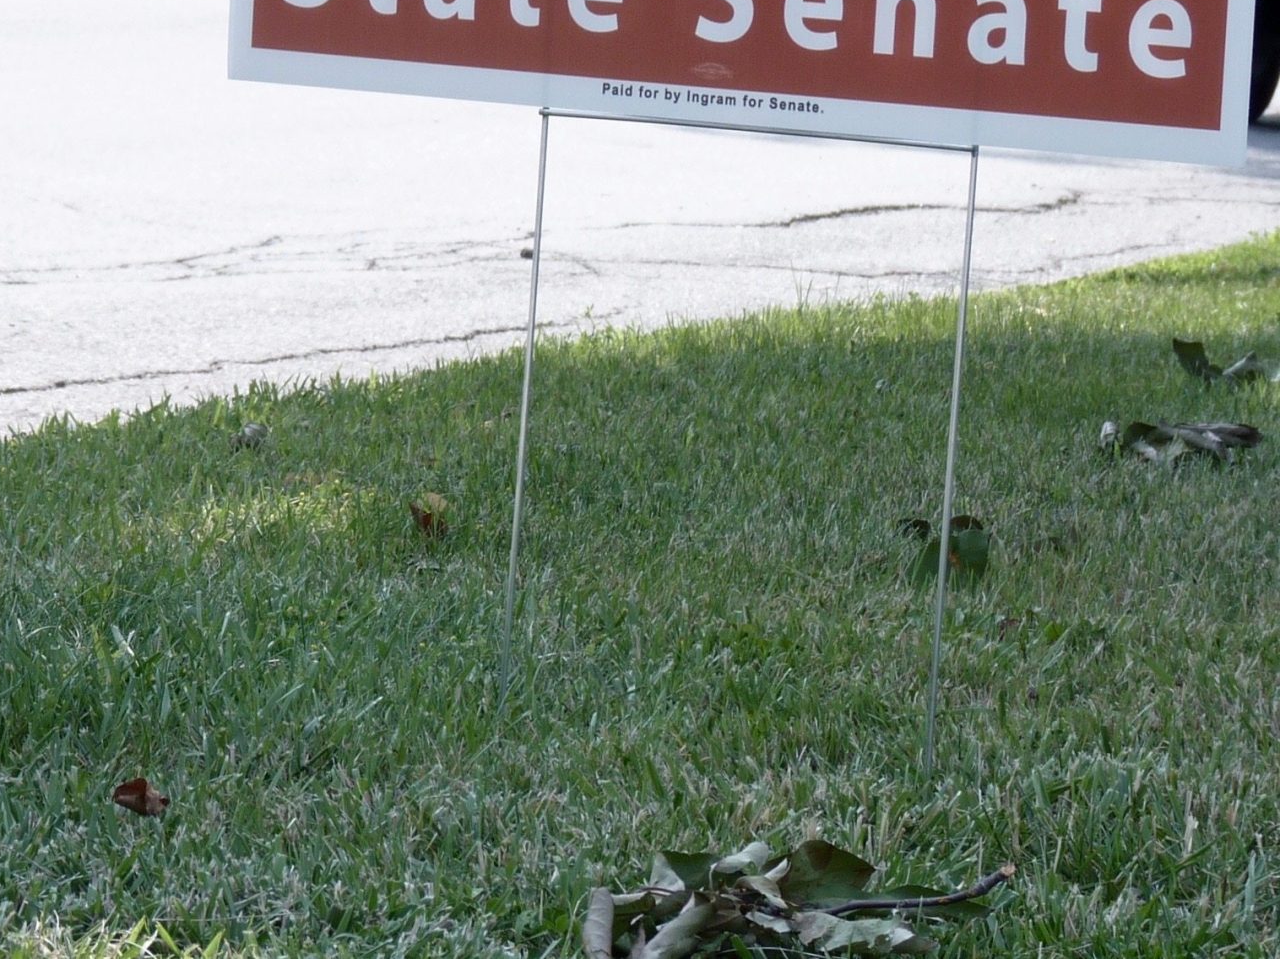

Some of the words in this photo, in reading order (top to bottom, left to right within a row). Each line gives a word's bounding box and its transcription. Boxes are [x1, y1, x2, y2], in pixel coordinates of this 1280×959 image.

[602, 82, 633, 97] Paid
[639, 85, 659, 99] for
[664, 88, 681, 104] by
[687, 90, 736, 106] Ingram
[742, 94, 764, 108] for
[769, 97, 824, 114] Senate.
